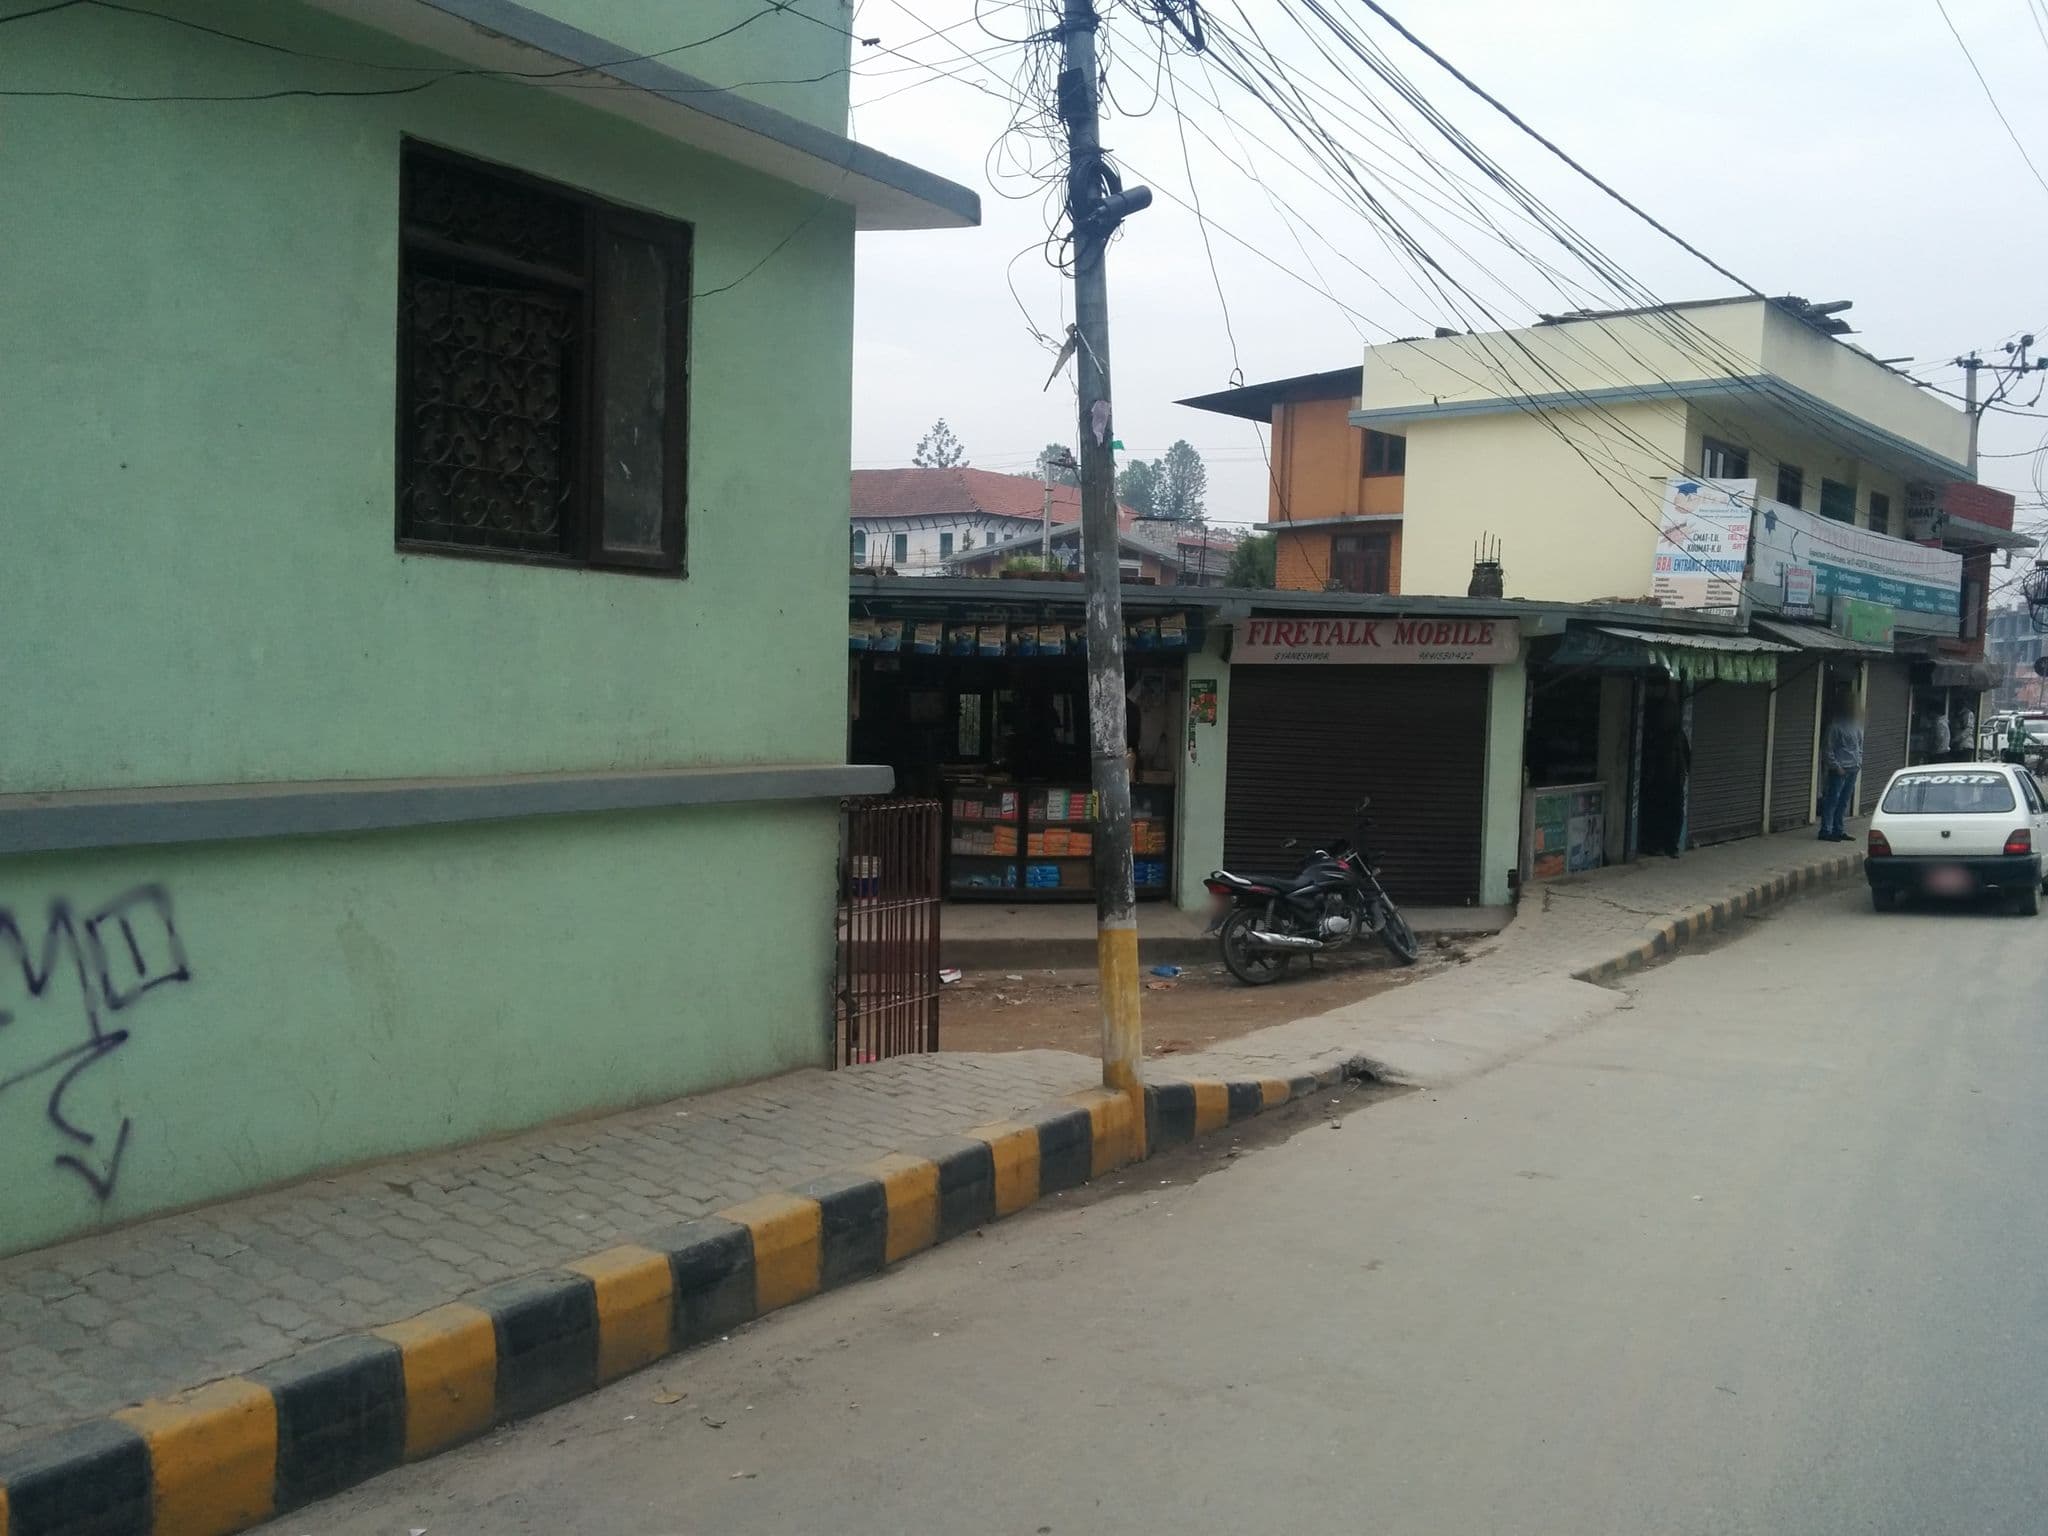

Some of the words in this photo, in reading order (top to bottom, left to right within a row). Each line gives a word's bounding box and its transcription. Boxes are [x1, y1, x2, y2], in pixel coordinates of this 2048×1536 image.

[1656, 557, 1671, 571] BBA
[1673, 558, 1704, 572] ENTRANCE
[1705, 558, 1745, 573] PREPARATION
[1246, 621, 1381, 647] FIRETALK
[1392, 621, 1496, 646] MOBILE
[1898, 775, 1999, 786] SPORTS
